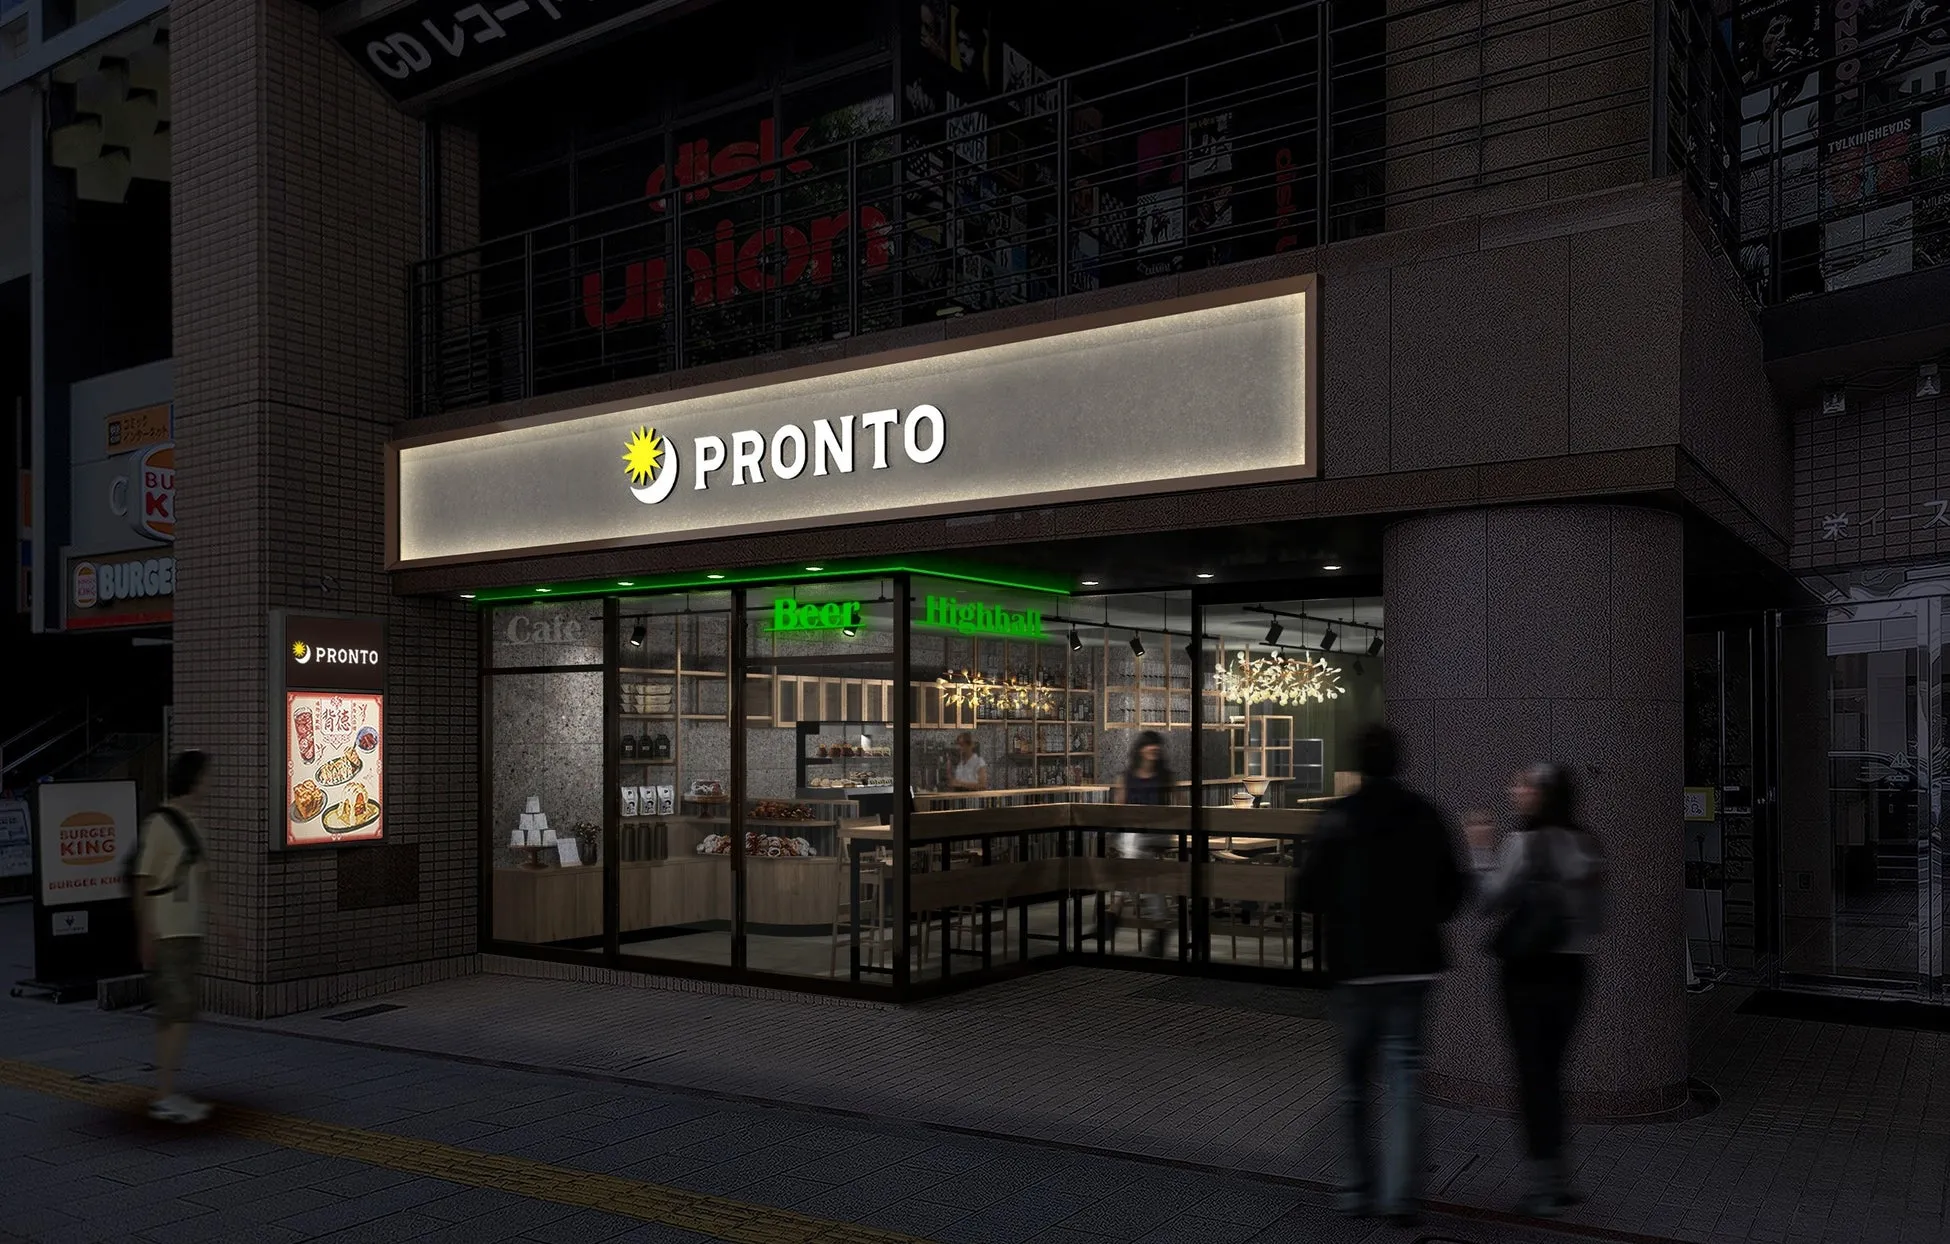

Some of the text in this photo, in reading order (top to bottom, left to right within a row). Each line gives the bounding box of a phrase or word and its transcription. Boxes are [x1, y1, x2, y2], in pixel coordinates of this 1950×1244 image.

[366, 31, 432, 80] CD
[644, 115, 815, 213] disk
[582, 204, 890, 331] union
[694, 404, 945, 490] PRONTO
[100, 557, 176, 600] BURGE
[774, 598, 861, 629] Beer
[927, 595, 1043, 637] Highball
[316, 646, 379, 665] PRONTO
[60, 826, 116, 840] BURGER
[60, 839, 116, 857] KING
[48, 878, 97, 891] BURGER
